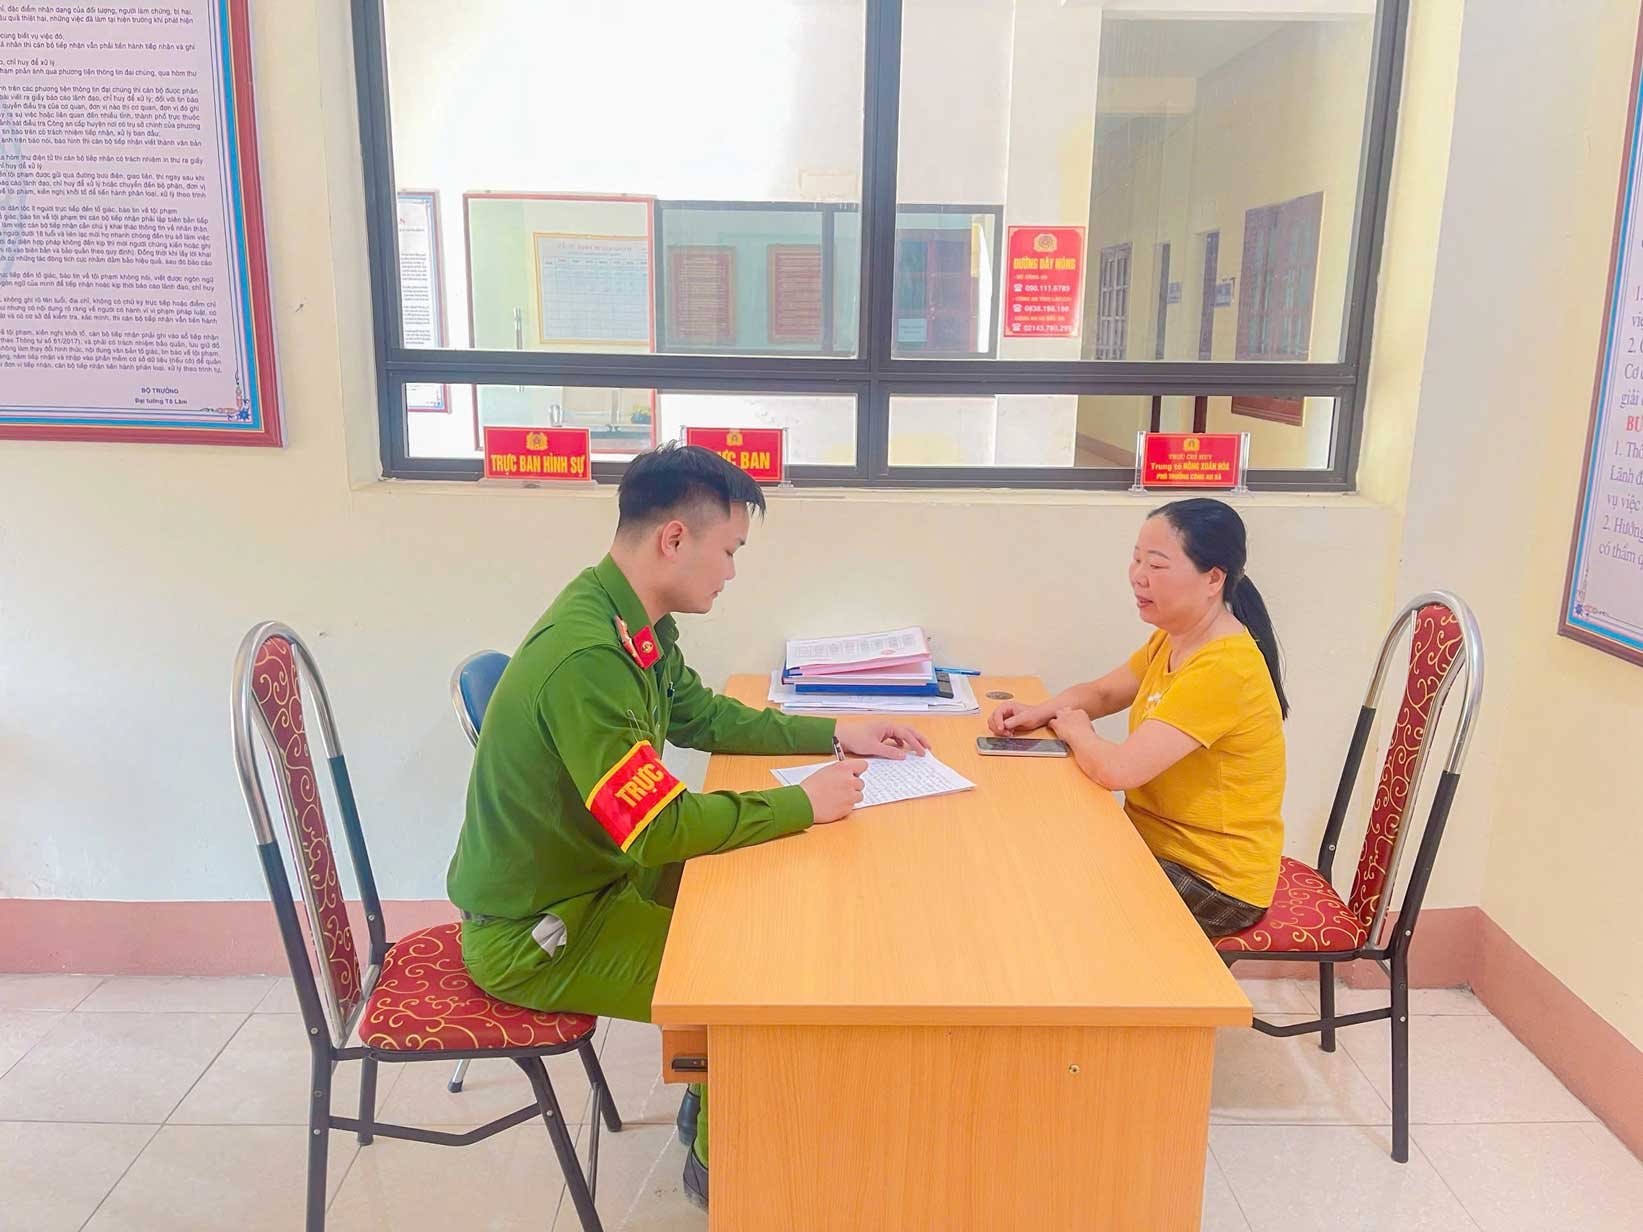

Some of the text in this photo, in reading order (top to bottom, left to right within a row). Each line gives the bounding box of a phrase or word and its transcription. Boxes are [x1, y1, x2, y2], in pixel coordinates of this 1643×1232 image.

[491, 452, 586, 478] TRỰC BAN HÌNH SỰ
[740, 451, 770, 470] BAN
[1151, 462, 1173, 472] Trung
[1610, 464, 1634, 484] Lãnh
[1607, 494, 1641, 514] vụ việc
[1598, 541, 1611, 556] có
[614, 763, 665, 807] TRỰC
